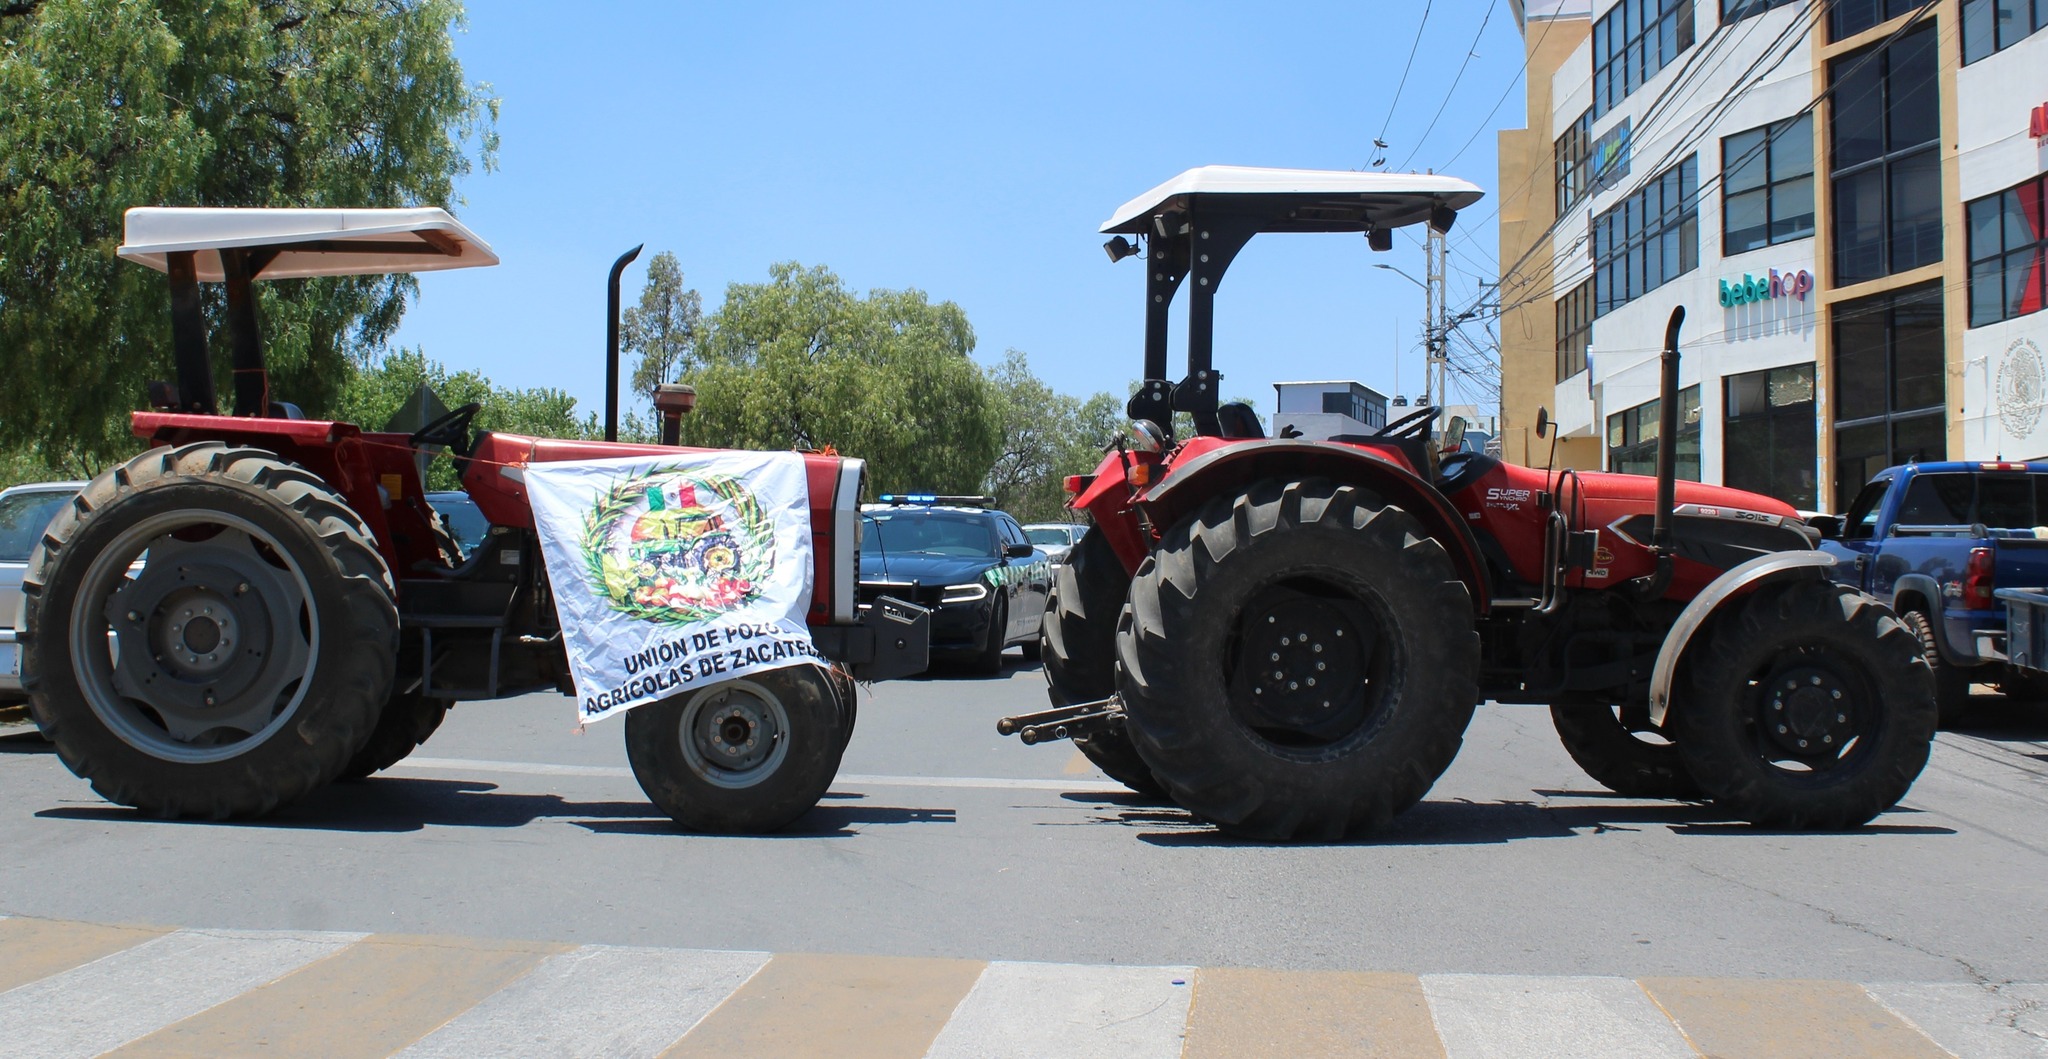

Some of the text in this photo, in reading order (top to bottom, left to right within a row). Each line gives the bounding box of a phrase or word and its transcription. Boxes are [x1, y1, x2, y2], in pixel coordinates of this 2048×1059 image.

[1718, 267, 1813, 308] bebehop
[1486, 488, 1530, 500] SUPER
[624, 638, 688, 675] UNIÓN
[692, 629, 721, 652] DE
[587, 663, 694, 715] AGRÍCOLAS
[698, 654, 727, 677] DE
